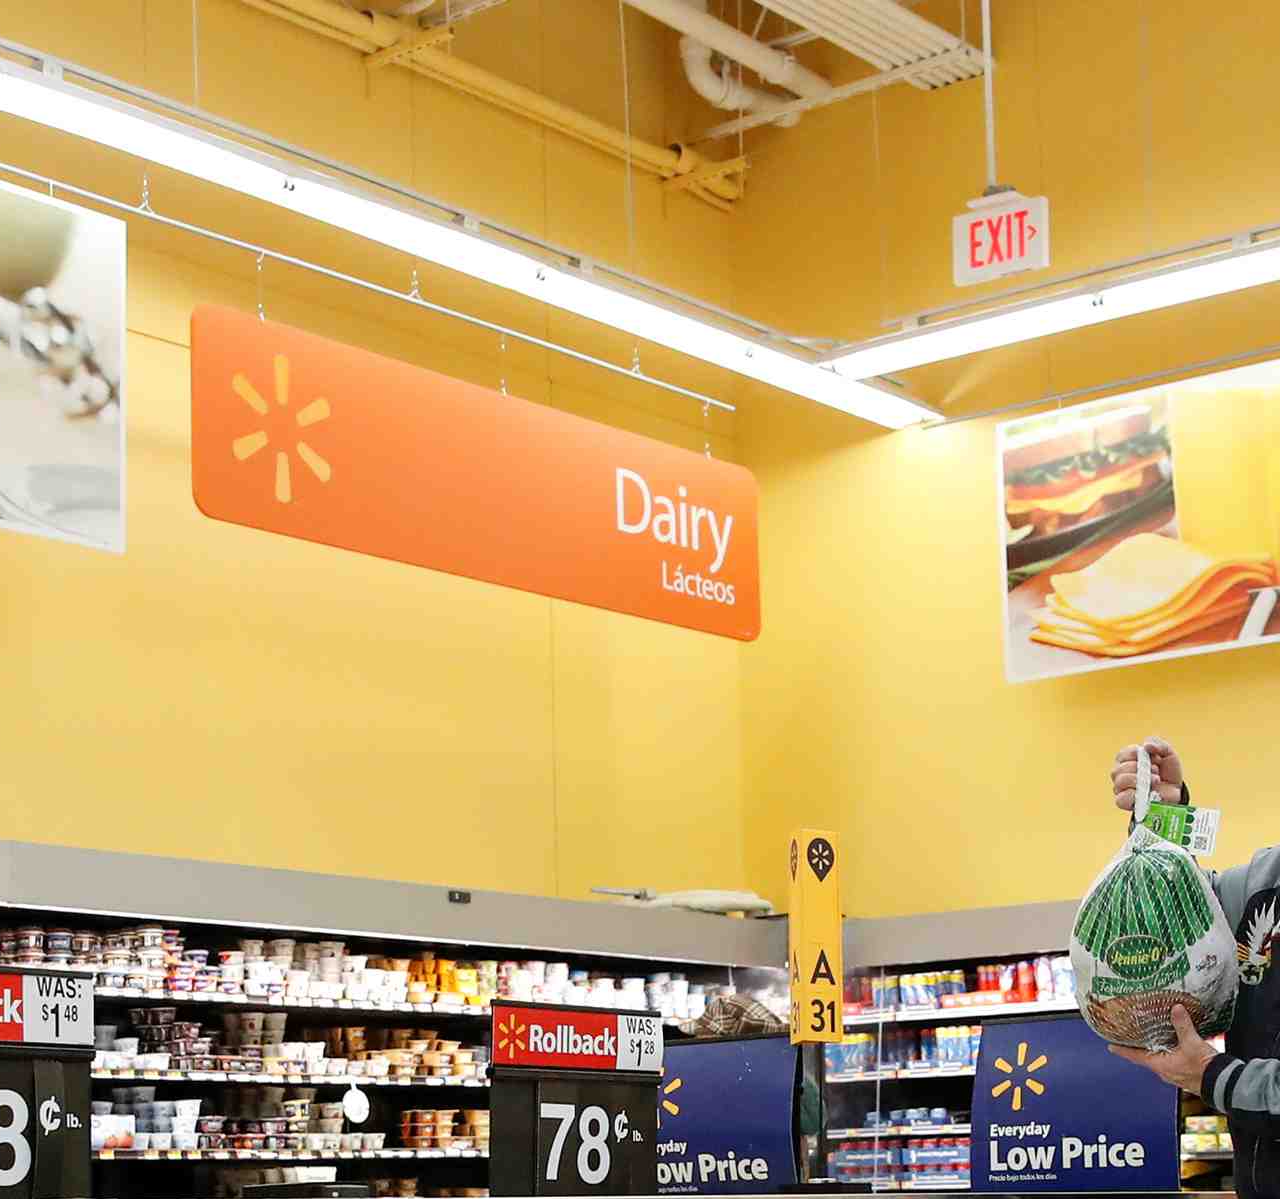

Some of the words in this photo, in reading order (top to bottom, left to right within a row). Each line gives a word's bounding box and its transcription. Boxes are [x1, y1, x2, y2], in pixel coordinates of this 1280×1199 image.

[968, 210, 1028, 268] EXIT
[616, 467, 733, 573] Dairy
[662, 560, 735, 605] Lácteos
[810, 949, 836, 985] A
[36, 976, 81, 999] WAS:
[626, 1017, 656, 1034] WAS:
[810, 998, 836, 1033] 31
[528, 1024, 616, 1056] Rollback
[66, 1114, 82, 1129] lb.
[632, 1129, 643, 1142] lb.
[990, 1122, 1051, 1139] Everyday
[656, 1139, 687, 1156] ryday
[990, 1140, 1056, 1172] Low
[1062, 1134, 1145, 1169] Price
[656, 1161, 693, 1185] ow
[698, 1150, 768, 1182] Price
